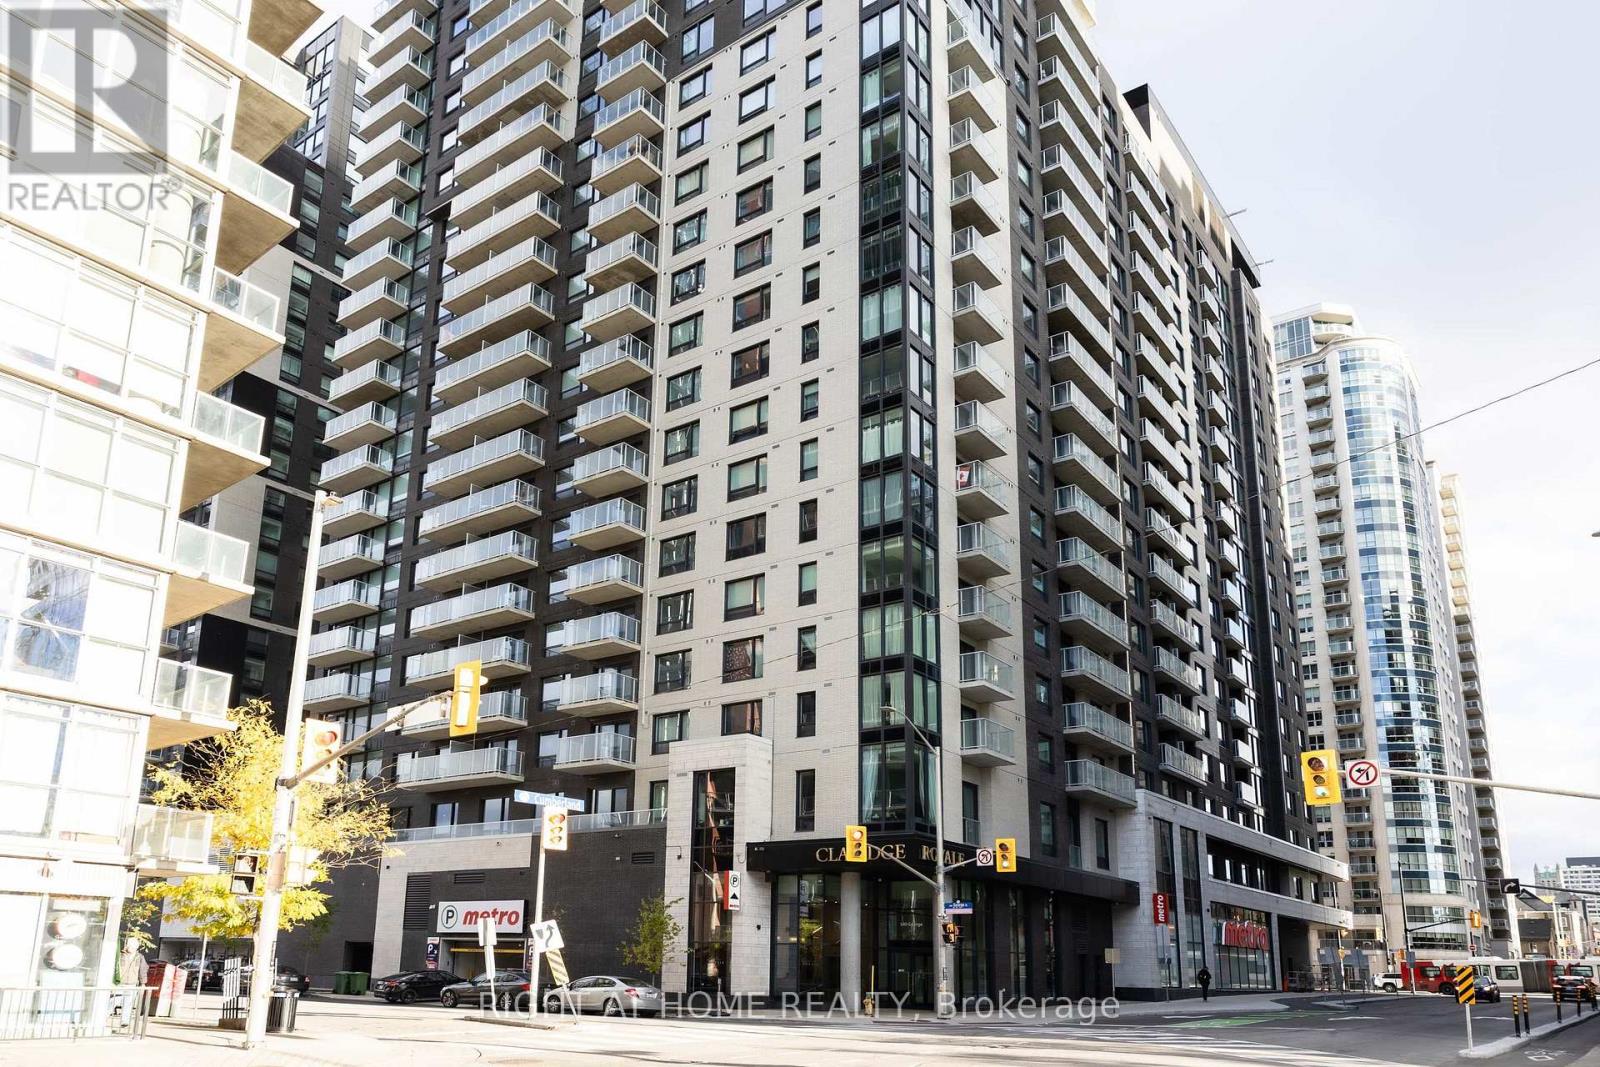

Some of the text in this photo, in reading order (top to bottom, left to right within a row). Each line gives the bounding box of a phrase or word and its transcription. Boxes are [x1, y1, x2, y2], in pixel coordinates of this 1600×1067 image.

[815, 843, 966, 867] CLADGE ROALE
[1157, 894, 1165, 922] metro
[1223, 919, 1270, 951] metro
